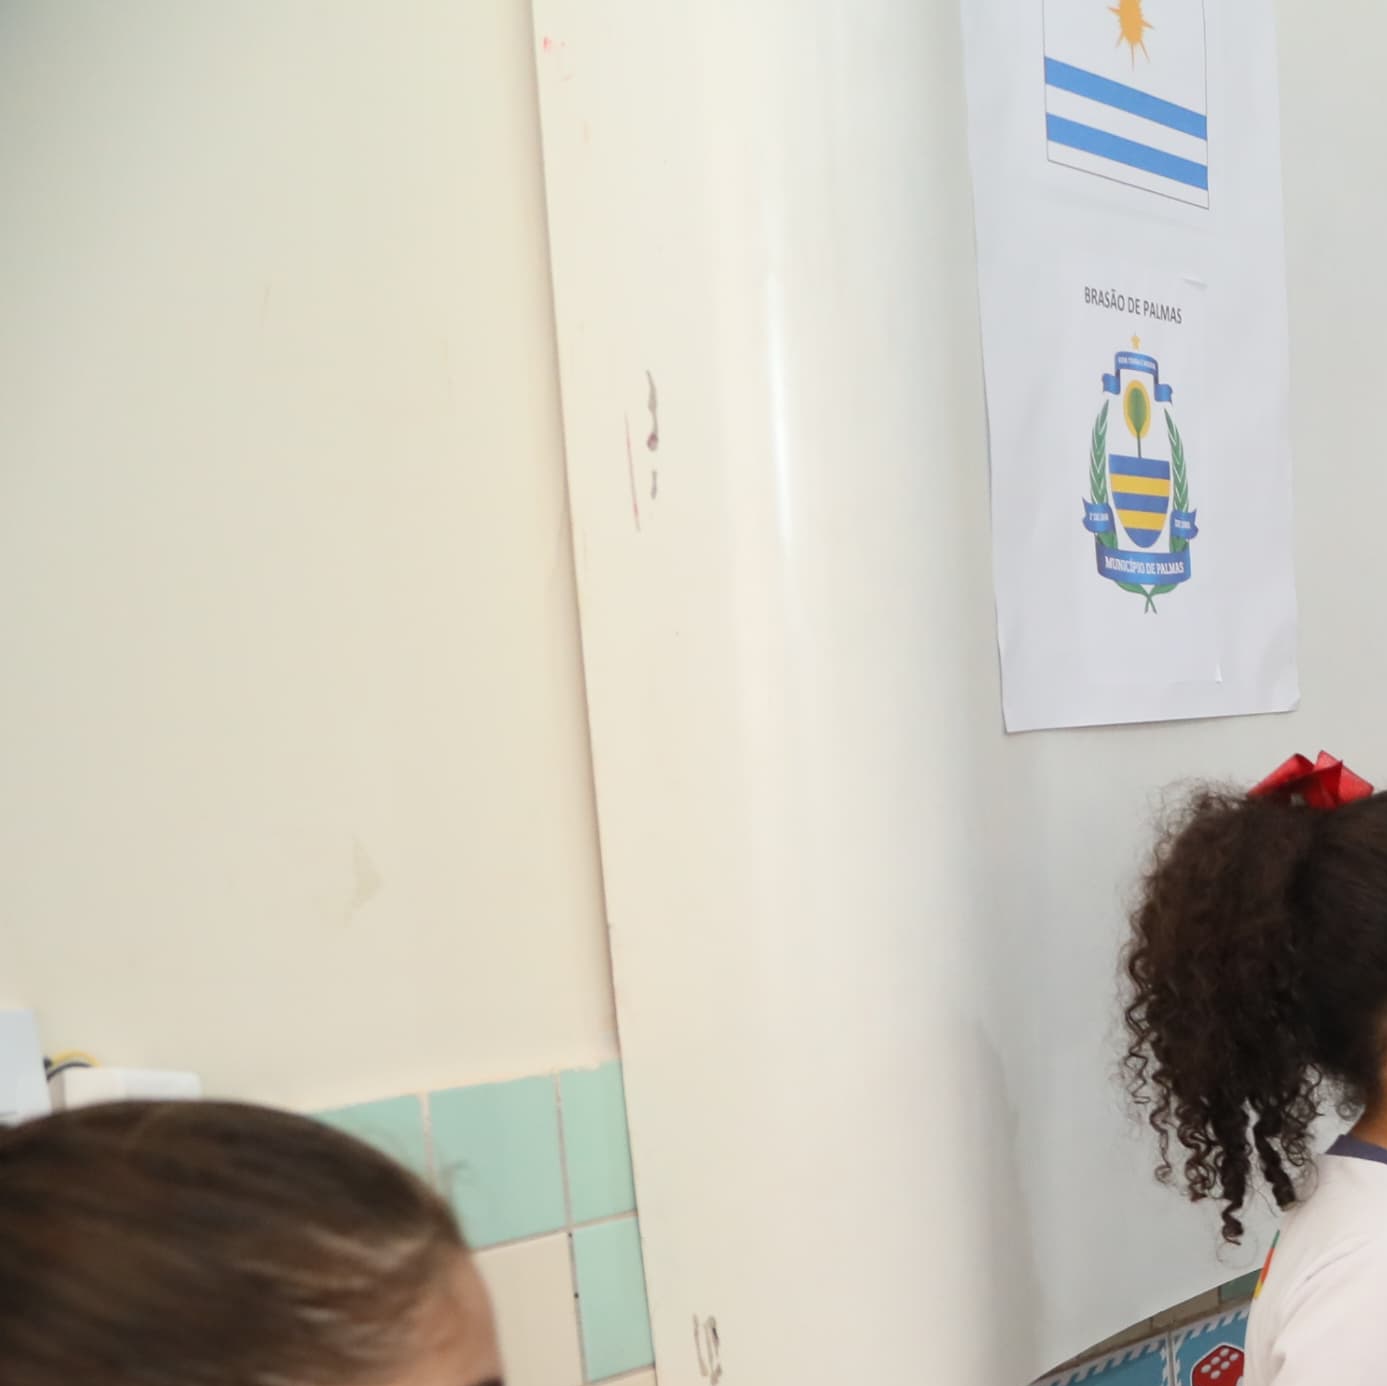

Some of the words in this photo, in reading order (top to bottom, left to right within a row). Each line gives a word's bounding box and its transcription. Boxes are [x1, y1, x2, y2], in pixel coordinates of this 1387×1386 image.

[1084, 286, 1126, 312] BRASÃO
[1127, 296, 1141, 315] DE
[1143, 300, 1183, 324] PALMAS
[1146, 560, 1157, 575] DE
[1157, 561, 1184, 575] PALMAS
